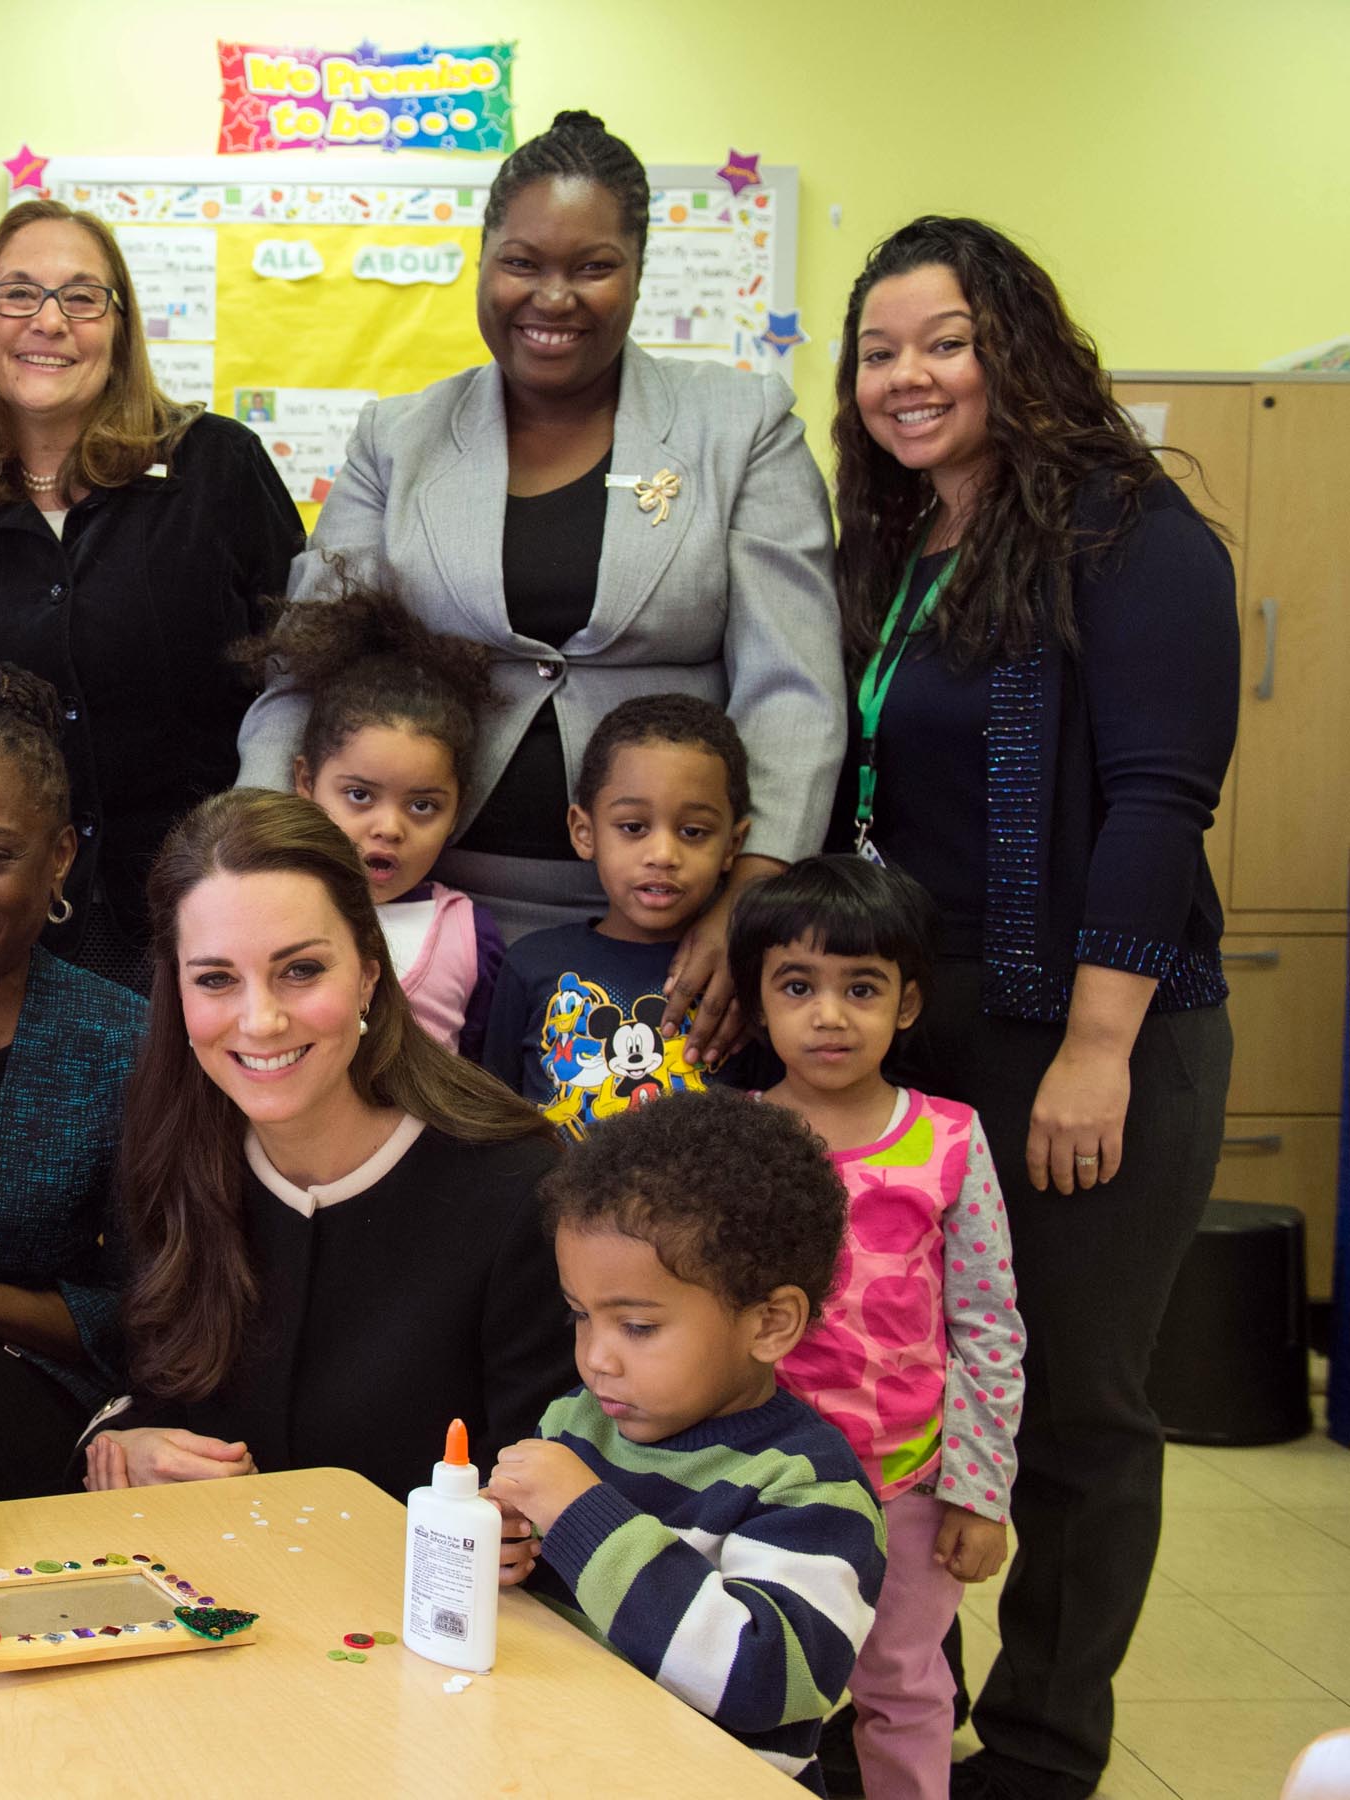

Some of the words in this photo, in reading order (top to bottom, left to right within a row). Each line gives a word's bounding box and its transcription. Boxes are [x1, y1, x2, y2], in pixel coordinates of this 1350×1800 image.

[247, 55, 319, 96] We
[323, 55, 499, 100] Promise
[271, 102, 324, 139] to
[259, 247, 313, 270] ALL
[356, 251, 462, 274] ABOUT
